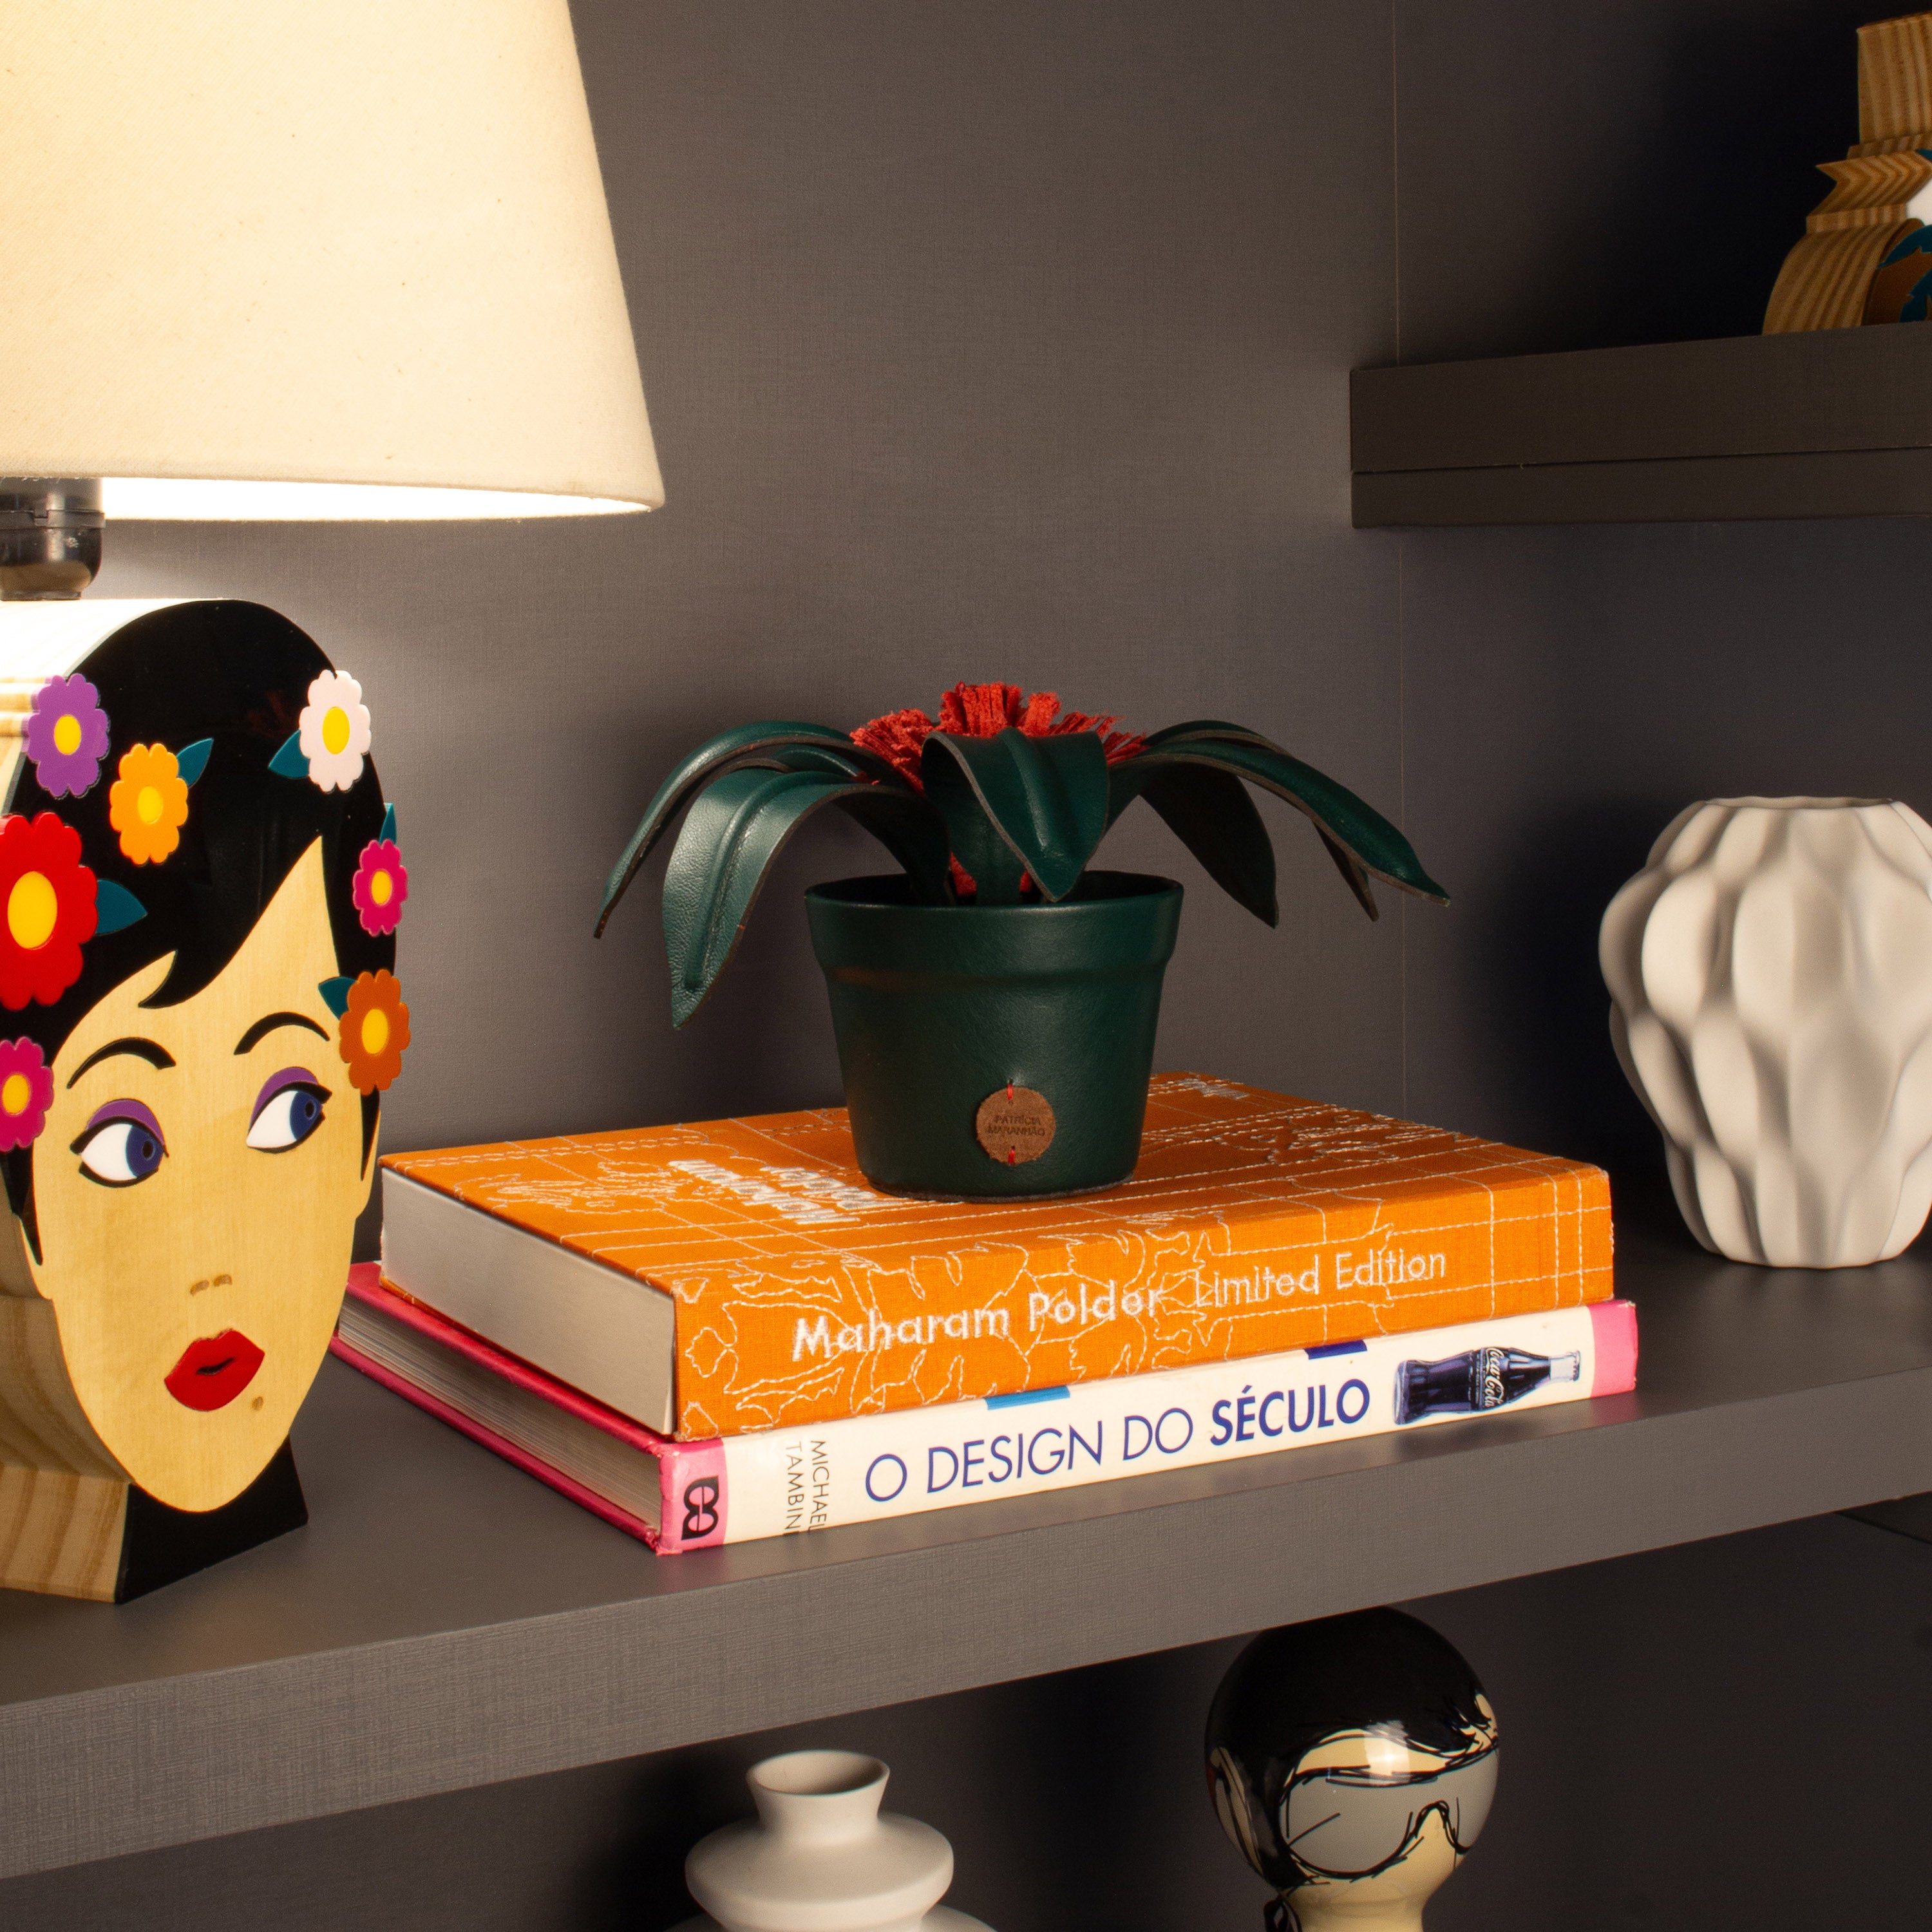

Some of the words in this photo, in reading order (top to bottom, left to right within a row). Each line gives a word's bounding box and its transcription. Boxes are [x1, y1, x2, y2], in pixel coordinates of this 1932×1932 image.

[668, 1159, 861, 1225] Maharam
[759, 1166, 907, 1210] Polder
[792, 1307, 1010, 1361] Maharam
[1028, 1279, 1162, 1331] Polder
[1196, 1254, 1320, 1308] Limited
[1336, 1248, 1446, 1289] Edition
[866, 1454, 907, 1502] O
[927, 1421, 1102, 1493] DESIGN
[1123, 1407, 1193, 1460] DO
[1210, 1379, 1370, 1446] SÉCULO
